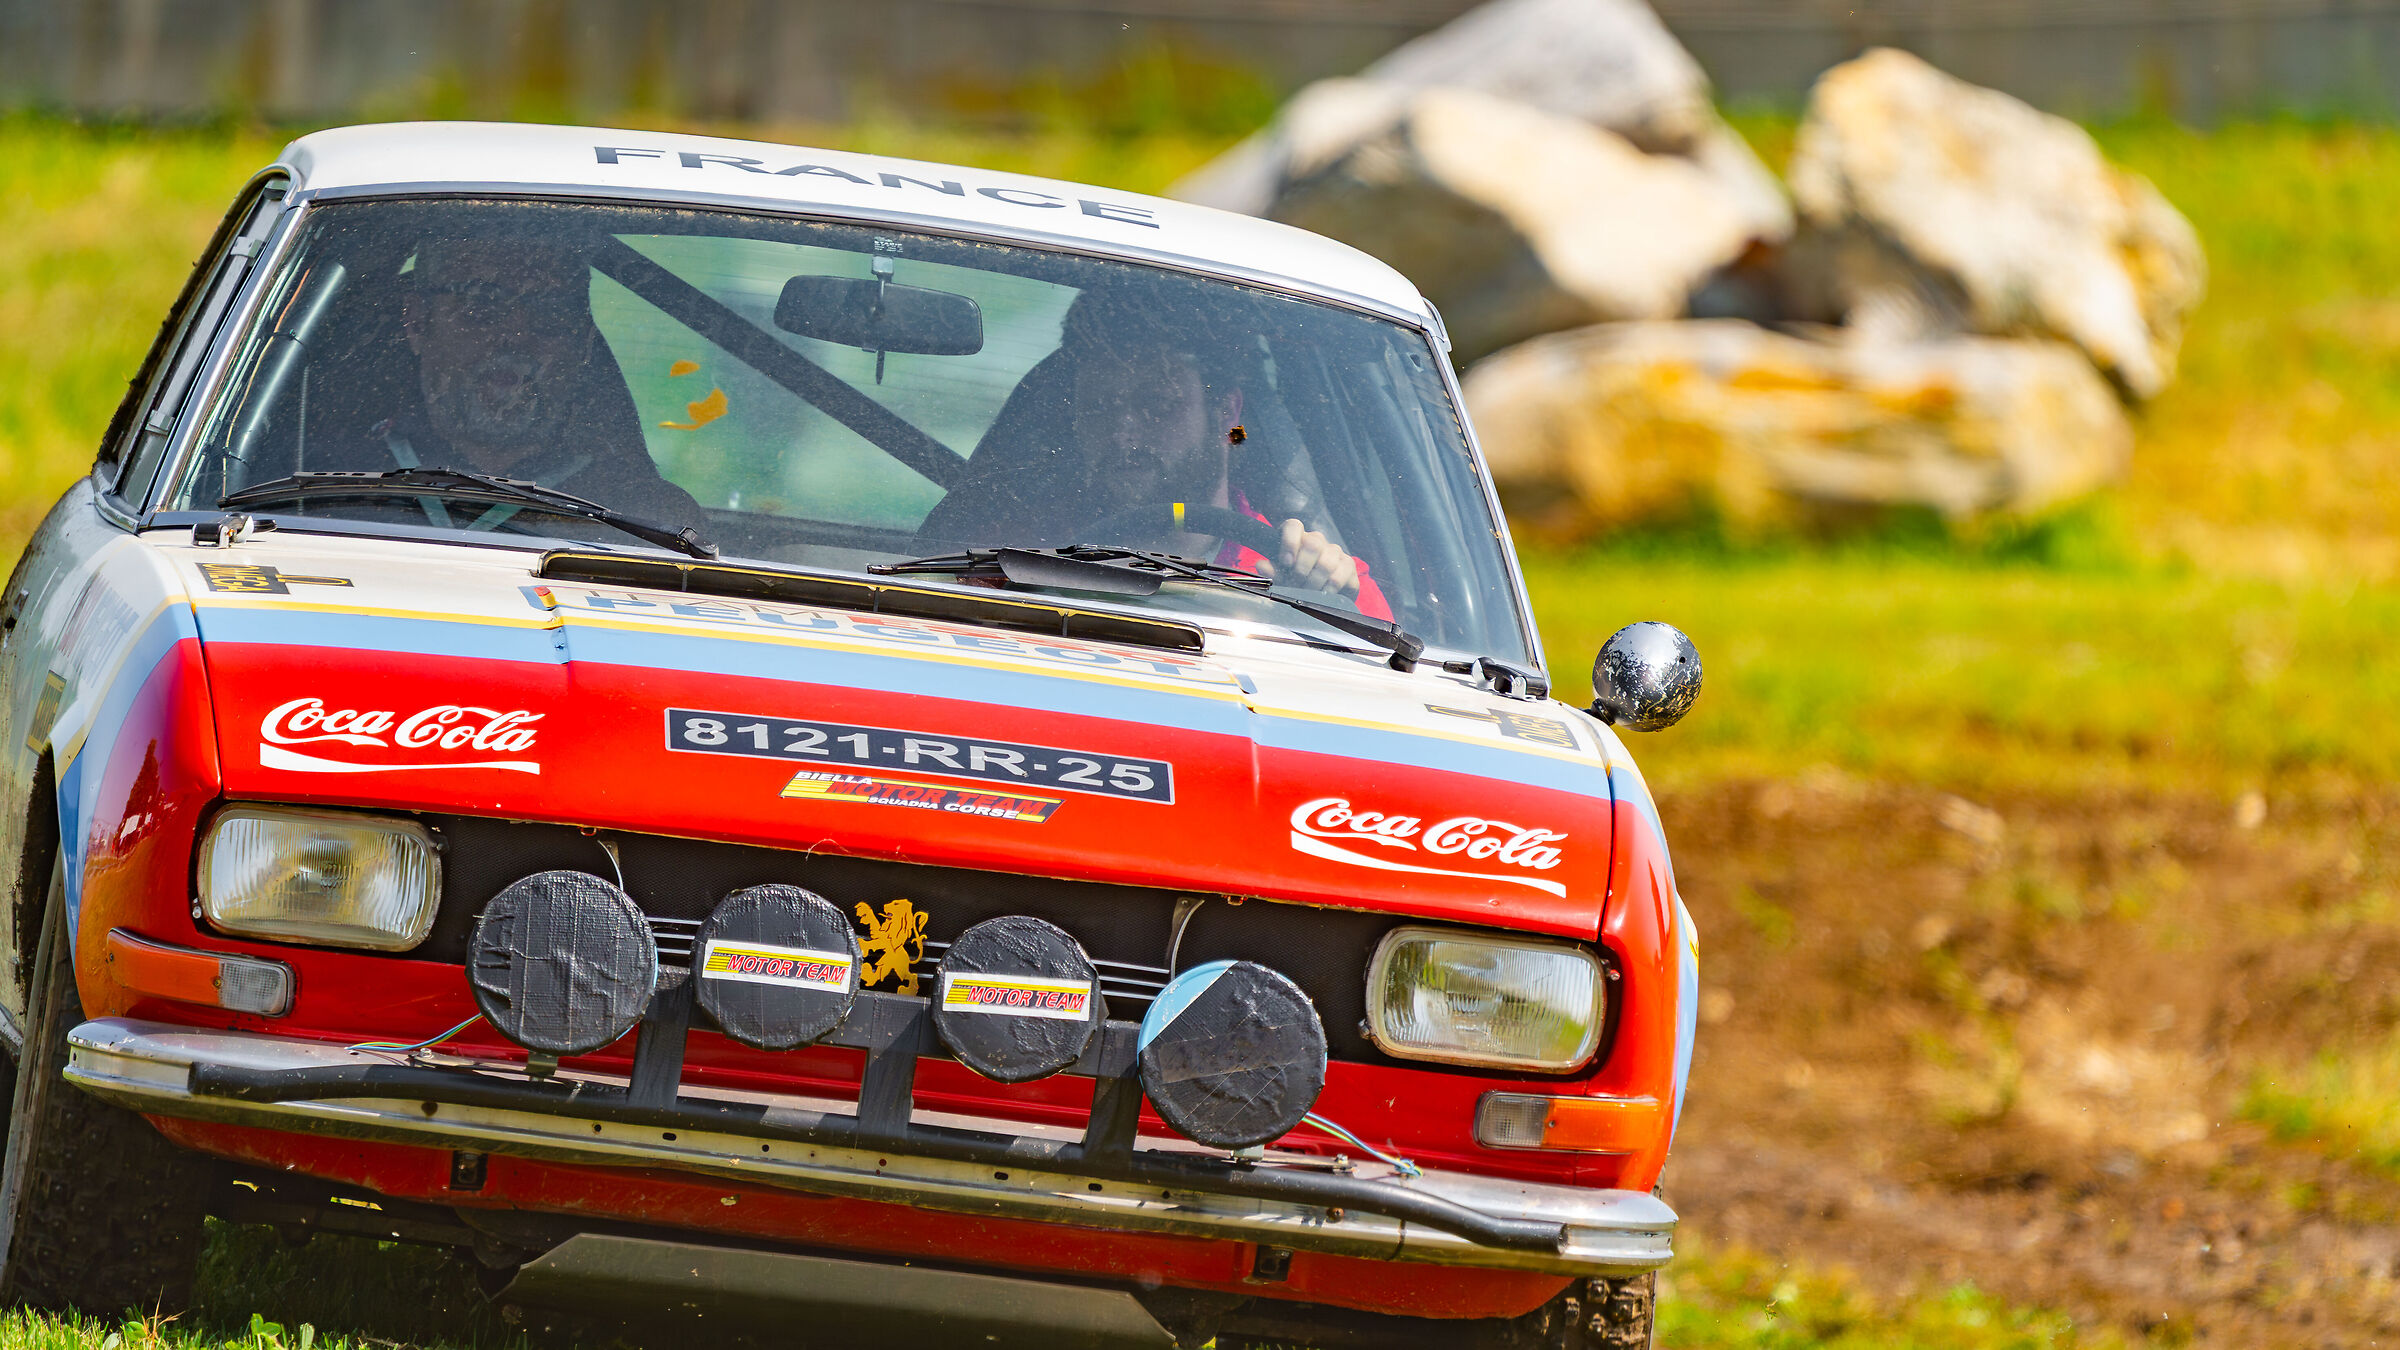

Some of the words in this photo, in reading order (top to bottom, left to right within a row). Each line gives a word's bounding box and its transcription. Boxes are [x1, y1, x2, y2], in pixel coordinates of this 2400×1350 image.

[594, 145, 1159, 229] FRANCE
[585, 596, 1203, 675] PEUGEOT
[260, 698, 396, 747] Coca
[394, 705, 546, 751] Cola
[795, 771, 874, 785] BIELLA
[826, 781, 948, 805] MOTOR
[956, 793, 1048, 817] TEAM
[867, 796, 939, 810] SQUADRA
[944, 803, 1020, 820] CORSE
[1290, 798, 1421, 851] Coca
[1422, 817, 1568, 870] Cola
[727, 955, 793, 976] MOTOR
[796, 962, 848, 983] TEAM
[967, 986, 1032, 1007] MOTOR
[1035, 991, 1087, 1010] TEAM
